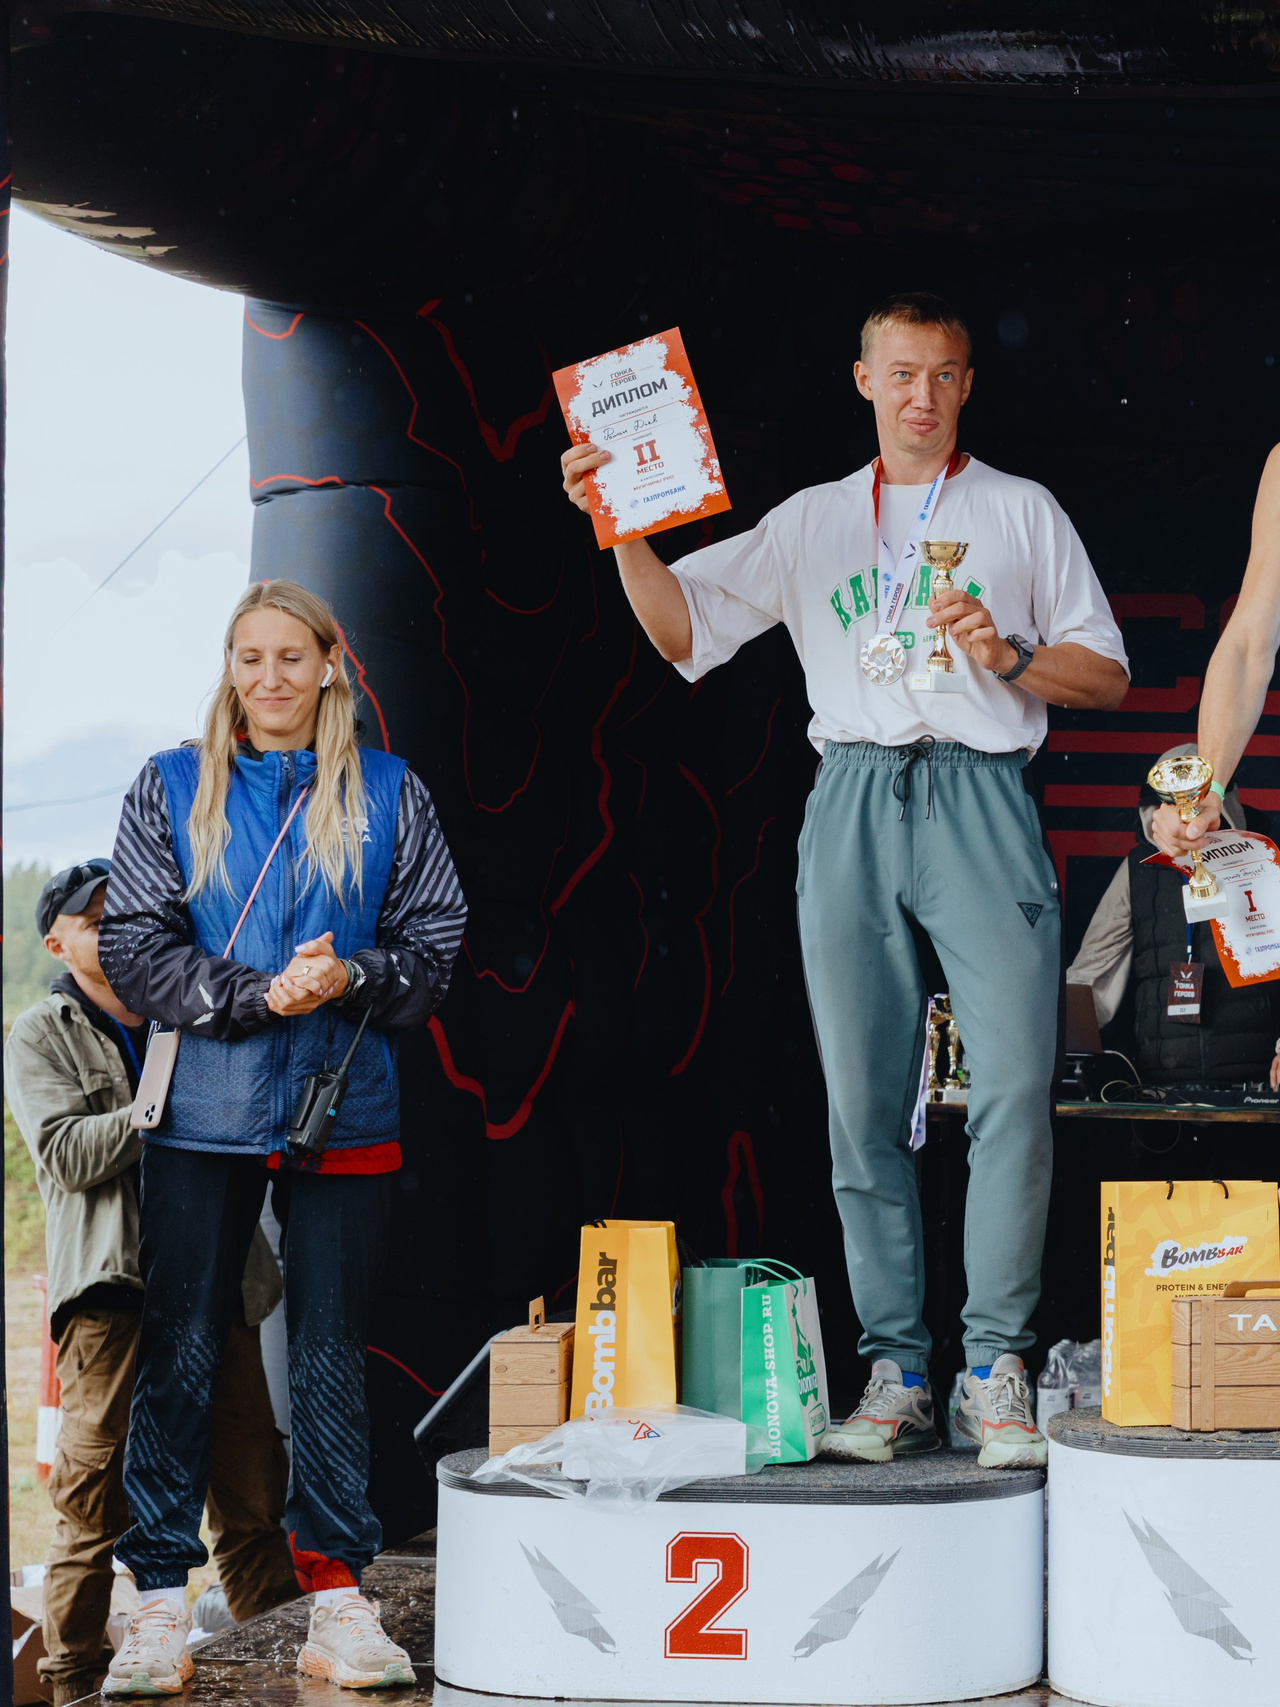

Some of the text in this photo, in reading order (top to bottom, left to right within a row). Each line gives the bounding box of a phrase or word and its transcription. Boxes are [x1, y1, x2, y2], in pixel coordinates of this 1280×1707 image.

[610, 367, 634, 380] ГОНКА
[610, 374, 638, 388] ГЕРОЕВ
[591, 377, 668, 418] ДИПЛОМ
[633, 439, 661, 467] II
[636, 461, 665, 476] МЕСТО
[642, 485, 686, 504] ГАЗПРОМБАНК
[1245, 913, 1266, 922] МЕСТО
[1175, 982, 1195, 990] ГОНКА
[1173, 990, 1195, 998] ГЕРОЕВ
[1243, 1096, 1279, 1104] Pioneer
[1156, 1283, 1196, 1292] PROTEIN
[584, 1252, 618, 1416] Bombbar
[762, 1294, 781, 1458] BIONOVA-SHOP.RU
[664, 1531, 749, 1661] 2
